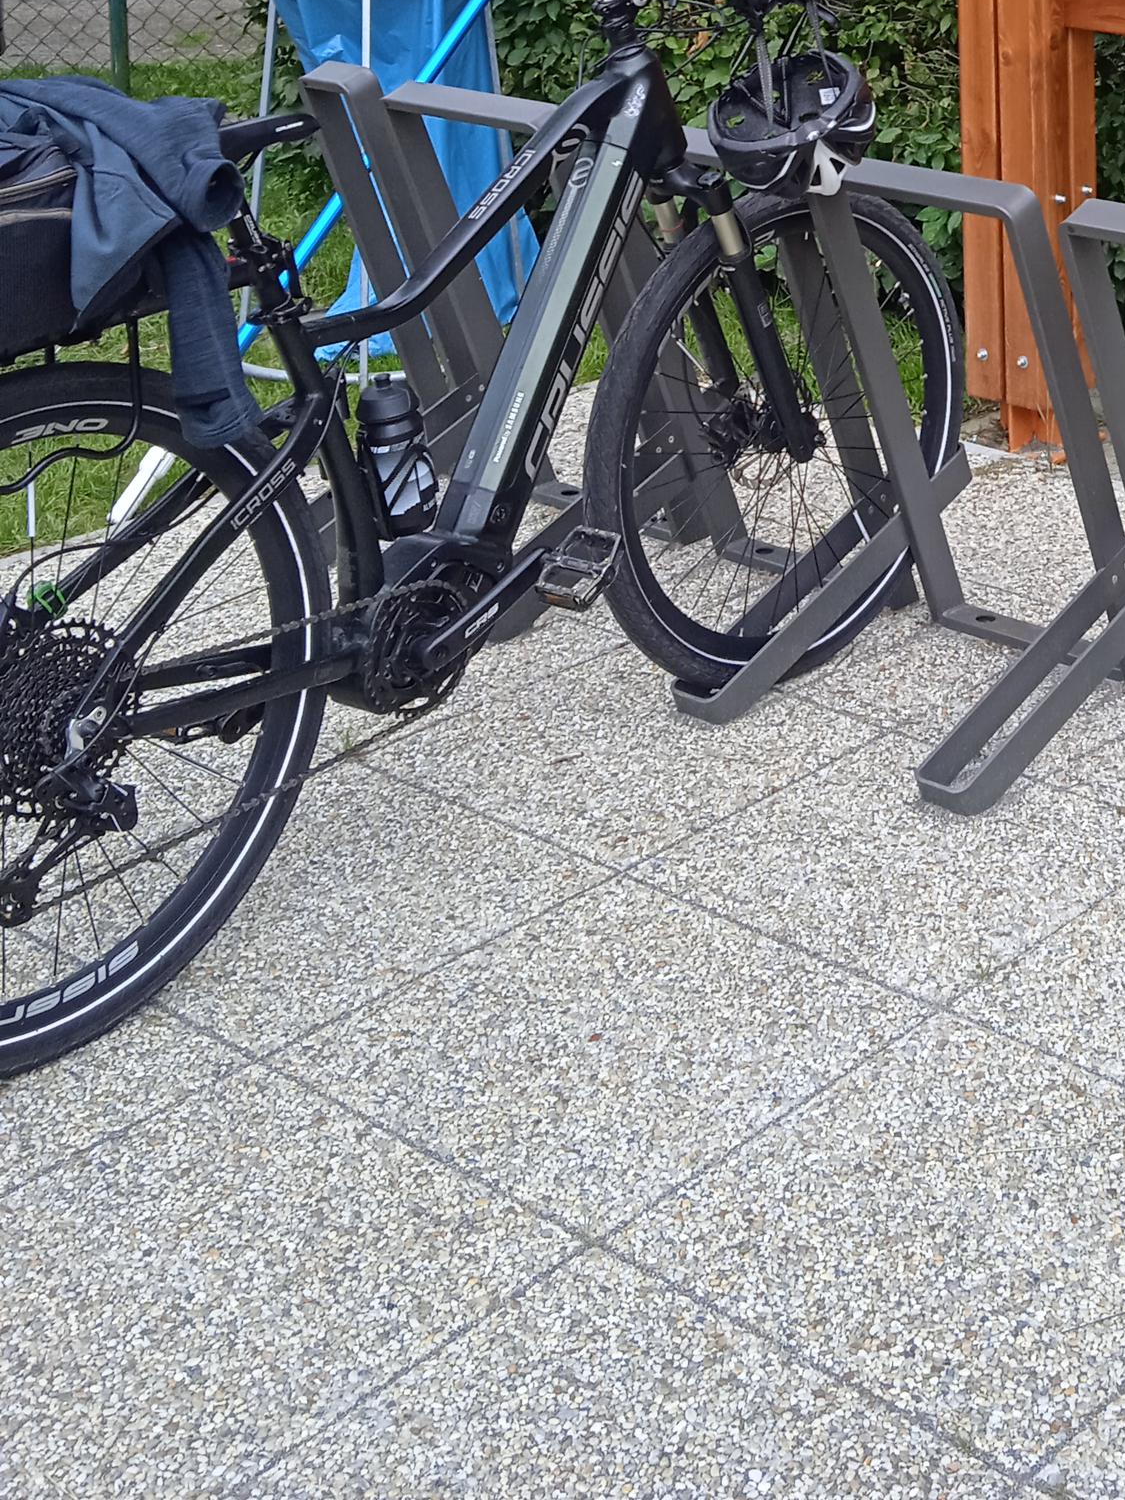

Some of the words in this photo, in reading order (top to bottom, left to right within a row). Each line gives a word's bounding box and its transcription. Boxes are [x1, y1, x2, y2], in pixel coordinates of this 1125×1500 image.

[524, 169, 644, 484] CRUSSIS
[11, 417, 109, 445] ONE
[505, 391, 525, 431] SAMSUNG
